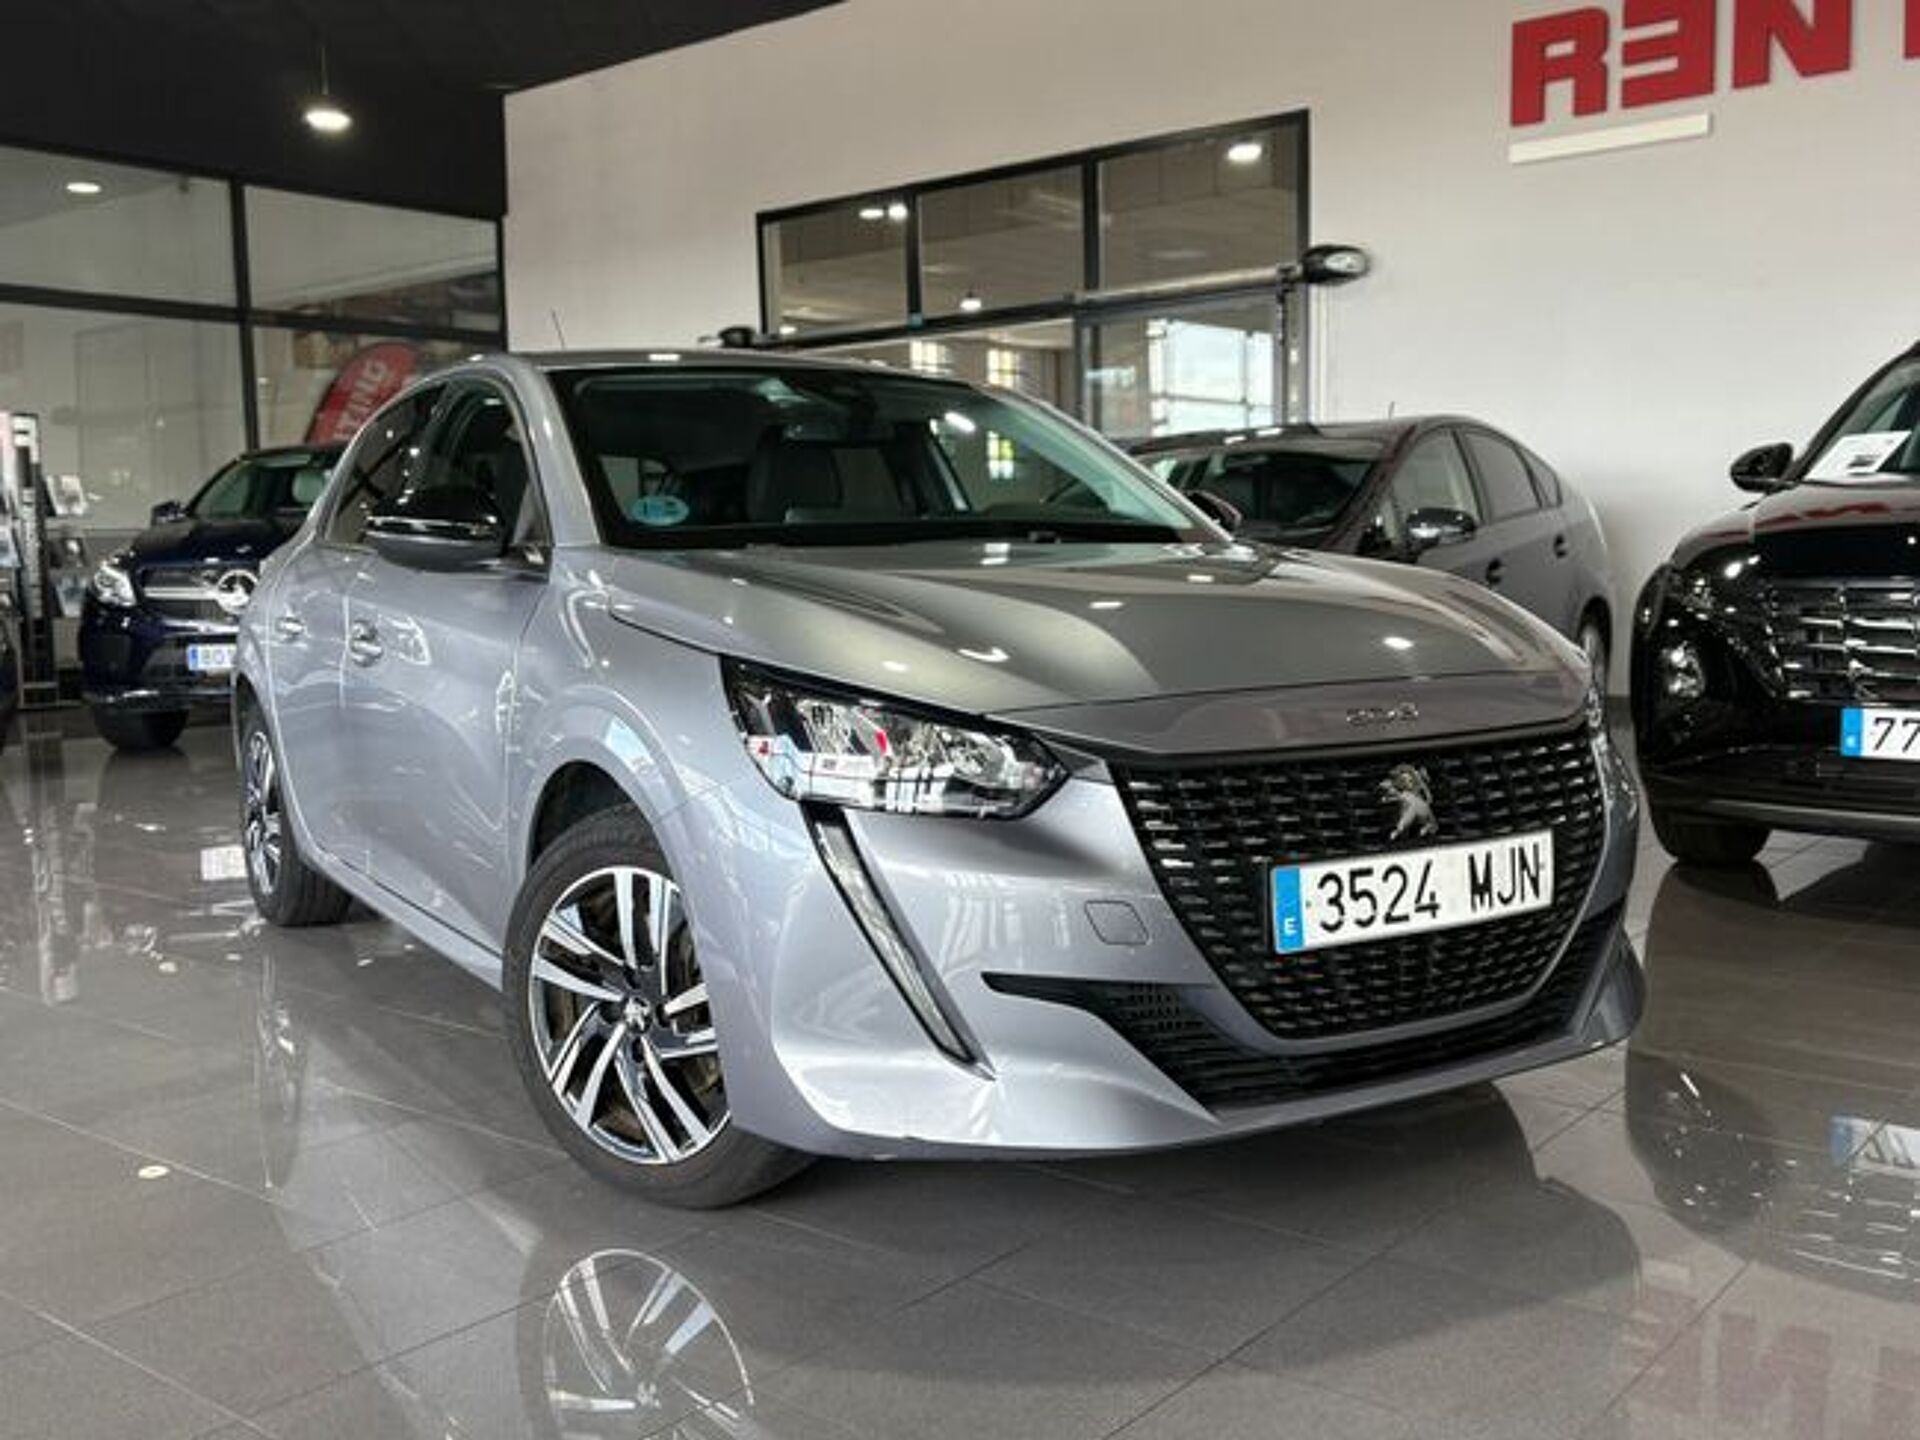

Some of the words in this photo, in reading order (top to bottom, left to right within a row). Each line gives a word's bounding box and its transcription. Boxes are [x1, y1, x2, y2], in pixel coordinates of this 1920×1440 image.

[1284, 916, 1297, 935] E
[1317, 859, 1440, 933] 3524
[1468, 842, 1541, 913] MJN
